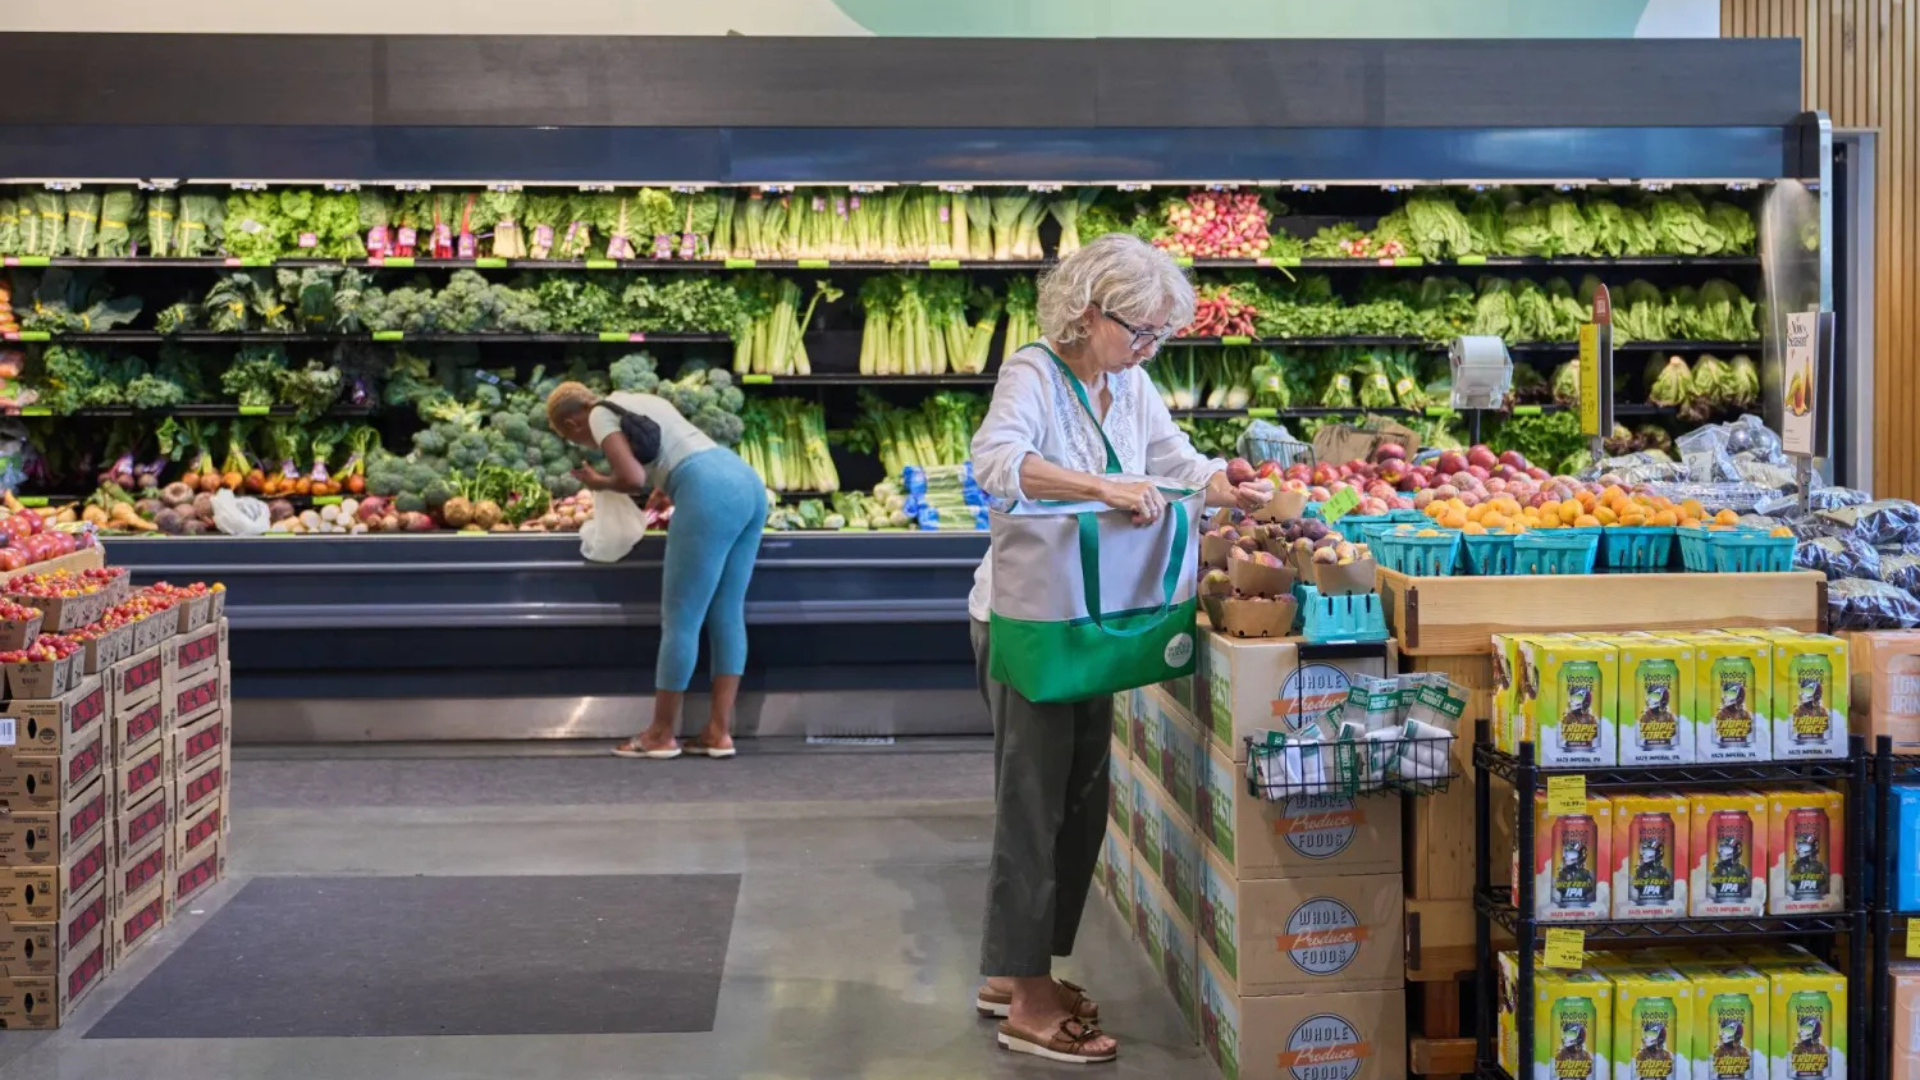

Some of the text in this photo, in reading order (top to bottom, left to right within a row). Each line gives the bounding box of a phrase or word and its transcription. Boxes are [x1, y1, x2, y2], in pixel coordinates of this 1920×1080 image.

[1294, 674, 1342, 690] WHOLE
[1640, 719, 1676, 731] TROPIC
[1716, 717, 1751, 729] TROPIC
[1793, 714, 1828, 725] TROPIC
[1562, 721, 1597, 733] TROPIC
[1793, 724, 1827, 734] FORCE
[1562, 732, 1596, 742] FORCE
[1640, 731, 1675, 740] FORCE
[1716, 728, 1750, 738] FORCE
[1289, 808, 1350, 833] Produce
[1299, 833, 1344, 848] FOODS
[1642, 886, 1661, 895] IPA
[1720, 883, 1739, 893] IPA
[1799, 880, 1817, 890] IPA
[1565, 887, 1583, 897] IPA
[1300, 910, 1347, 926] WHOLE
[1292, 925, 1353, 949] Produce
[1301, 950, 1346, 966] FOODS
[1301, 1026, 1349, 1042] WHOLE
[1294, 1041, 1355, 1066] Produce
[1792, 1052, 1828, 1063] TROPIC
[1556, 1059, 1592, 1070] TROPIC
[1637, 1059, 1673, 1070] TROPIC
[1713, 1055, 1749, 1066] TROPIC
[1303, 1065, 1349, 1080] FOODS
[1713, 1065, 1748, 1074] FORCE
[1792, 1062, 1827, 1072] FORCE
[1556, 1069, 1591, 1078] FORCE
[1637, 1069, 1672, 1078] FORCE
